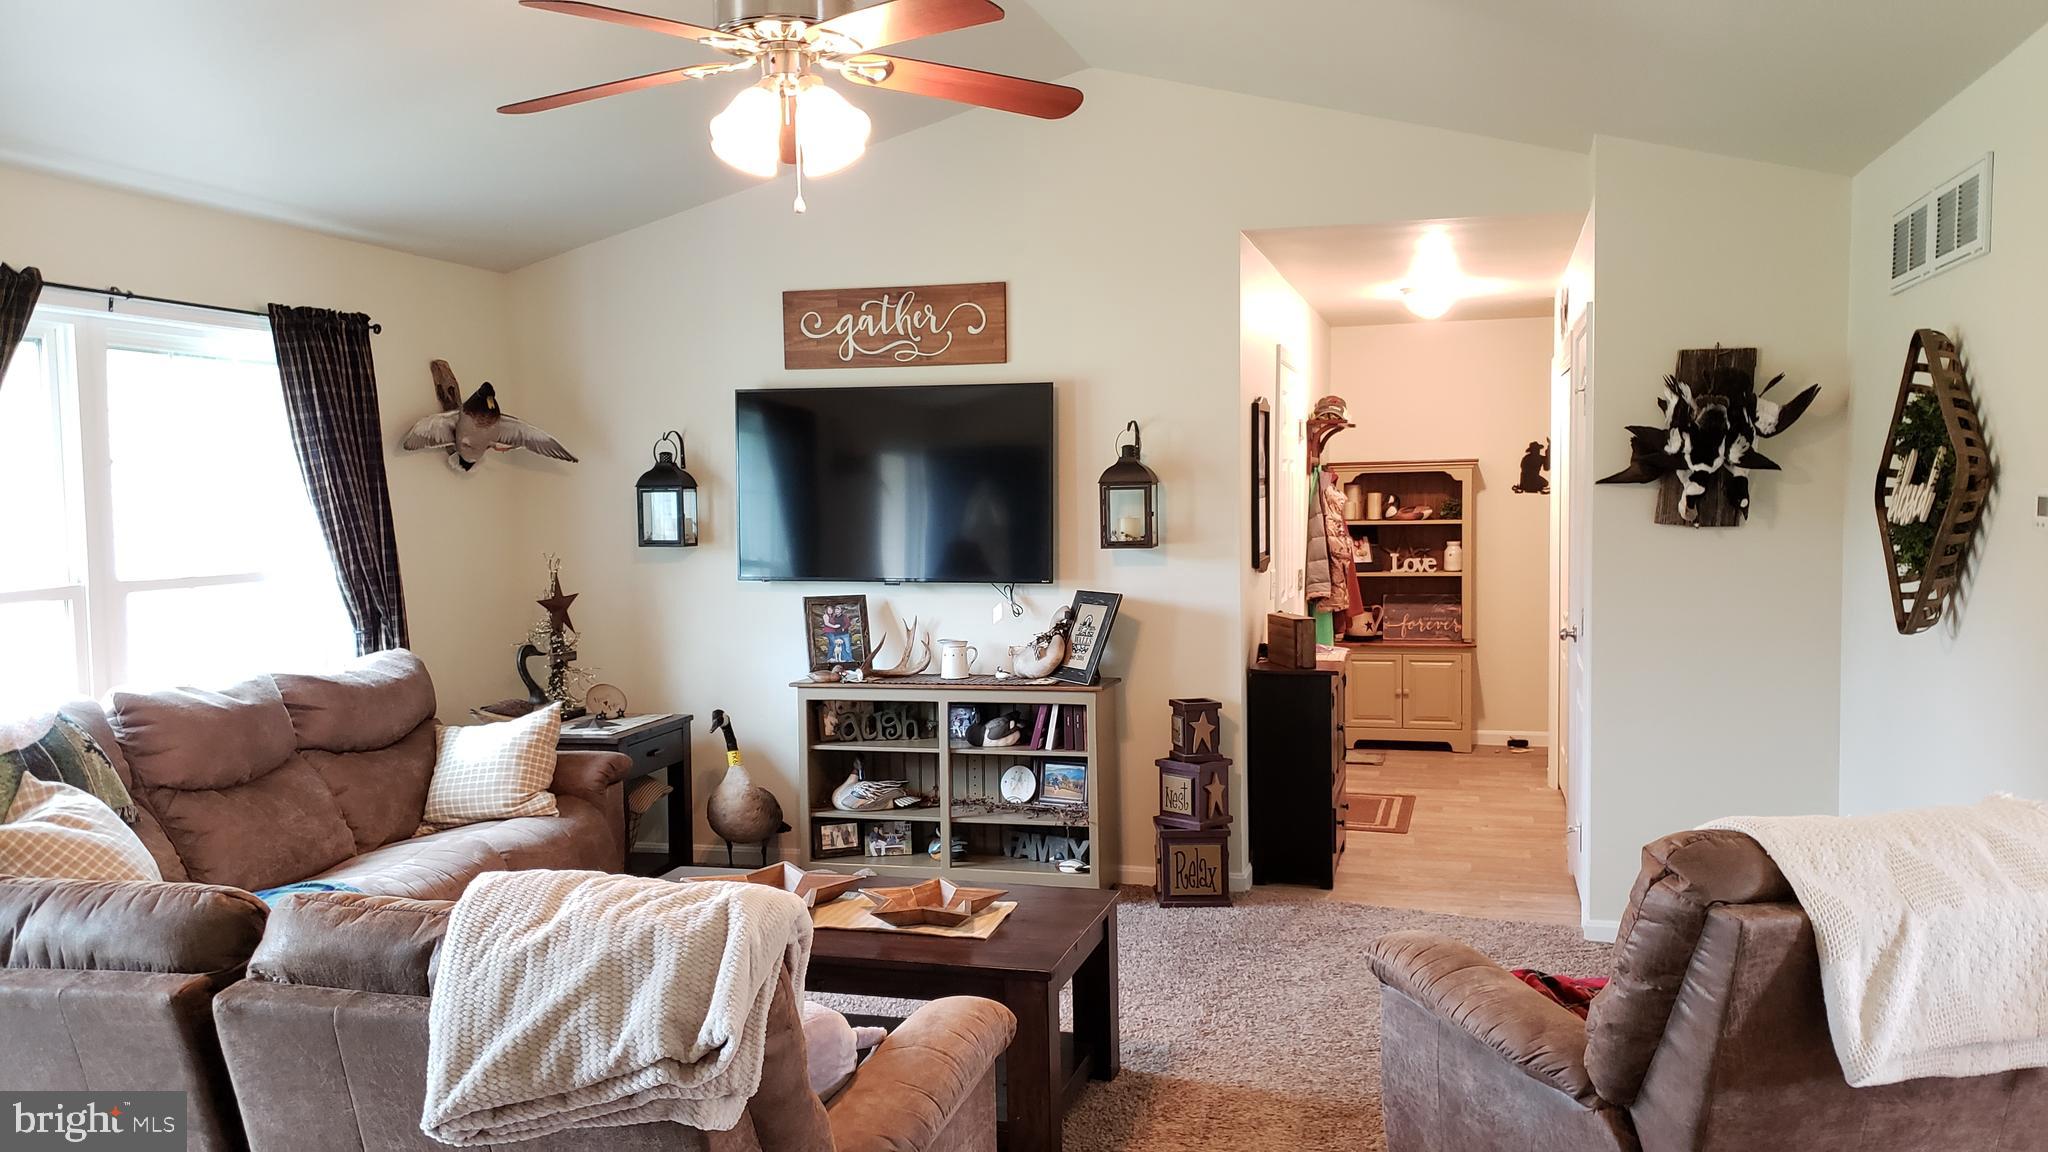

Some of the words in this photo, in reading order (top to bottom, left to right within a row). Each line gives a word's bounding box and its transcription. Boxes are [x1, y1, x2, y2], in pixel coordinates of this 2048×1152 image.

[800, 291, 987, 362] gather
[1390, 553, 1437, 573] Love
[1385, 613, 1462, 638] forever
[1165, 782, 1189, 811] Nest
[1174, 848, 1218, 892] Relax
